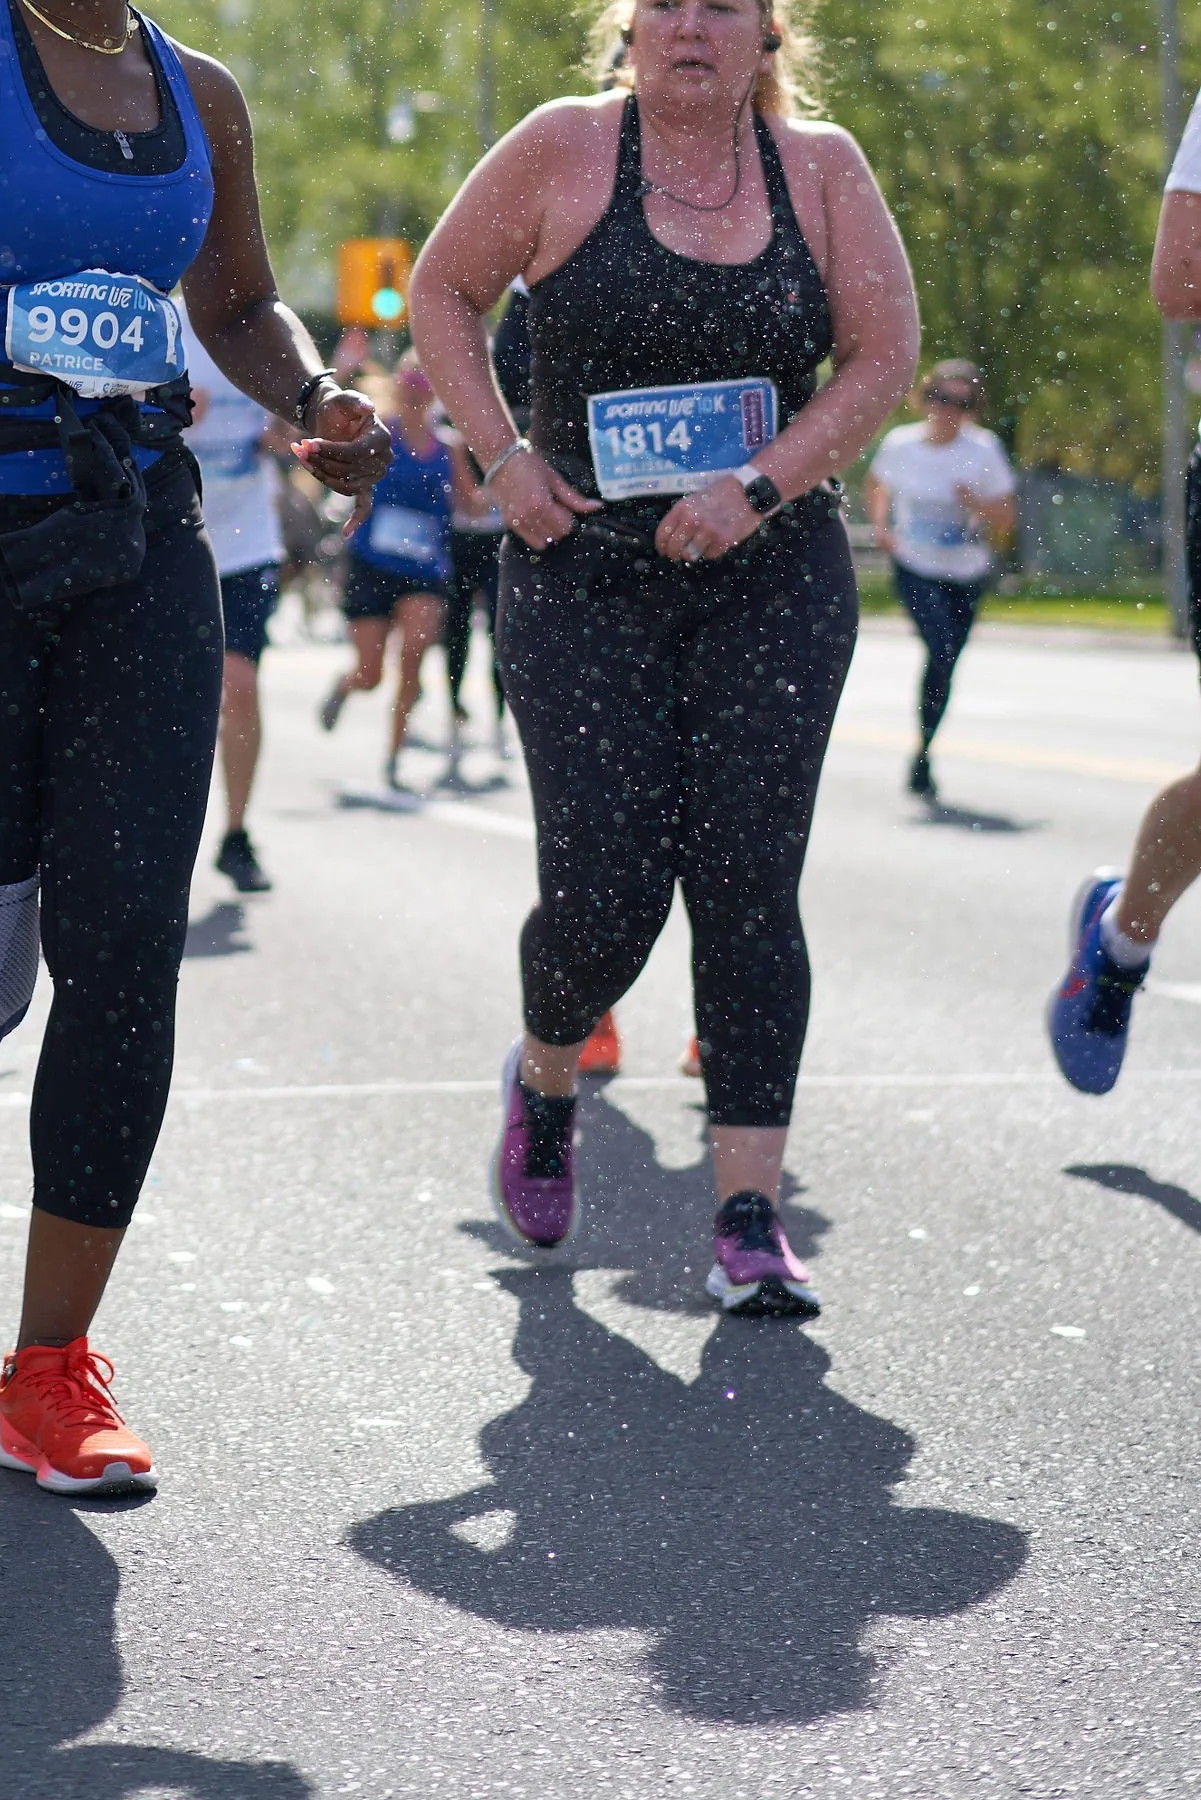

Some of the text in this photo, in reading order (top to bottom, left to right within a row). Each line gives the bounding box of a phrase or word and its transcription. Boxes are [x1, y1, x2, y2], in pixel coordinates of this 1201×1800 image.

[28, 306, 144, 352] 9904
[29, 351, 104, 372] PATRICE
[604, 419, 693, 458] 1814
